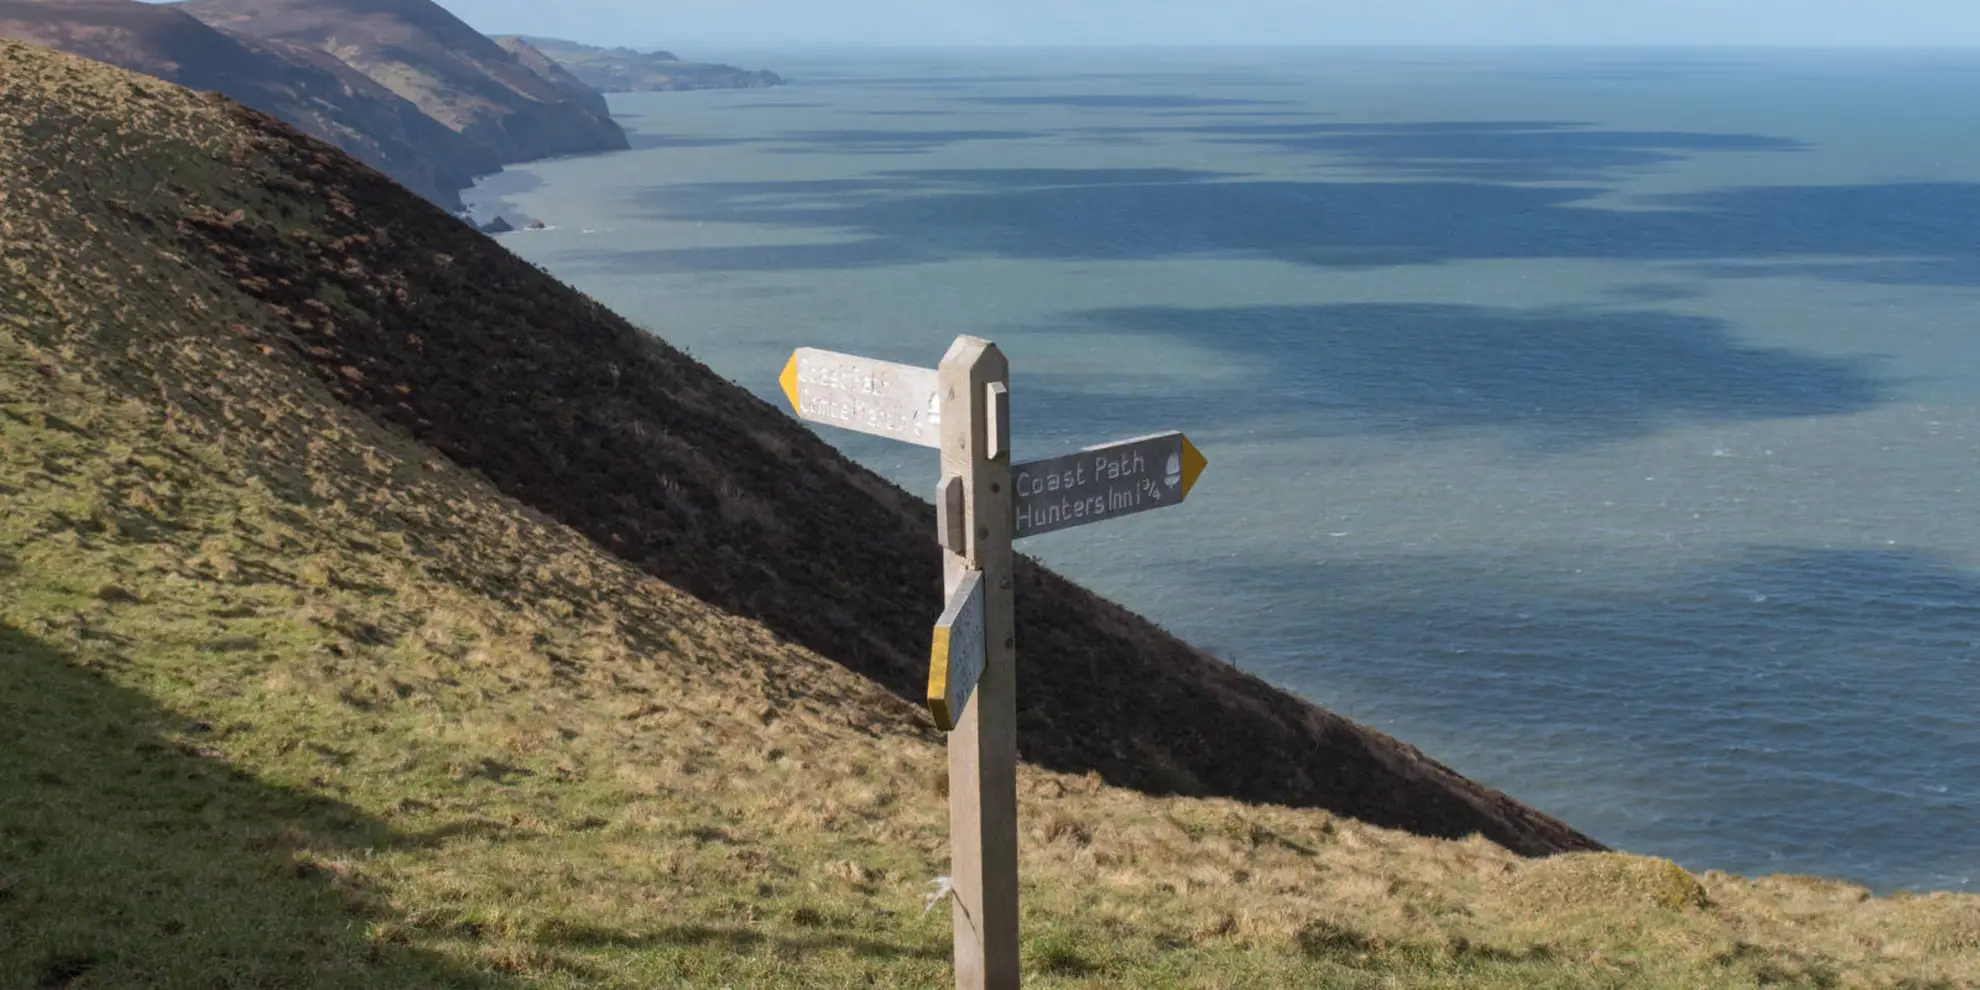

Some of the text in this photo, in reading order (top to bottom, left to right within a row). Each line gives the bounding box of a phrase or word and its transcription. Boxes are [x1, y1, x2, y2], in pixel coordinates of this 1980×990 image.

[1016, 449, 1145, 498] Coast Path
[1015, 494, 1105, 531] Hunters
[1108, 484, 1133, 511] Inn
